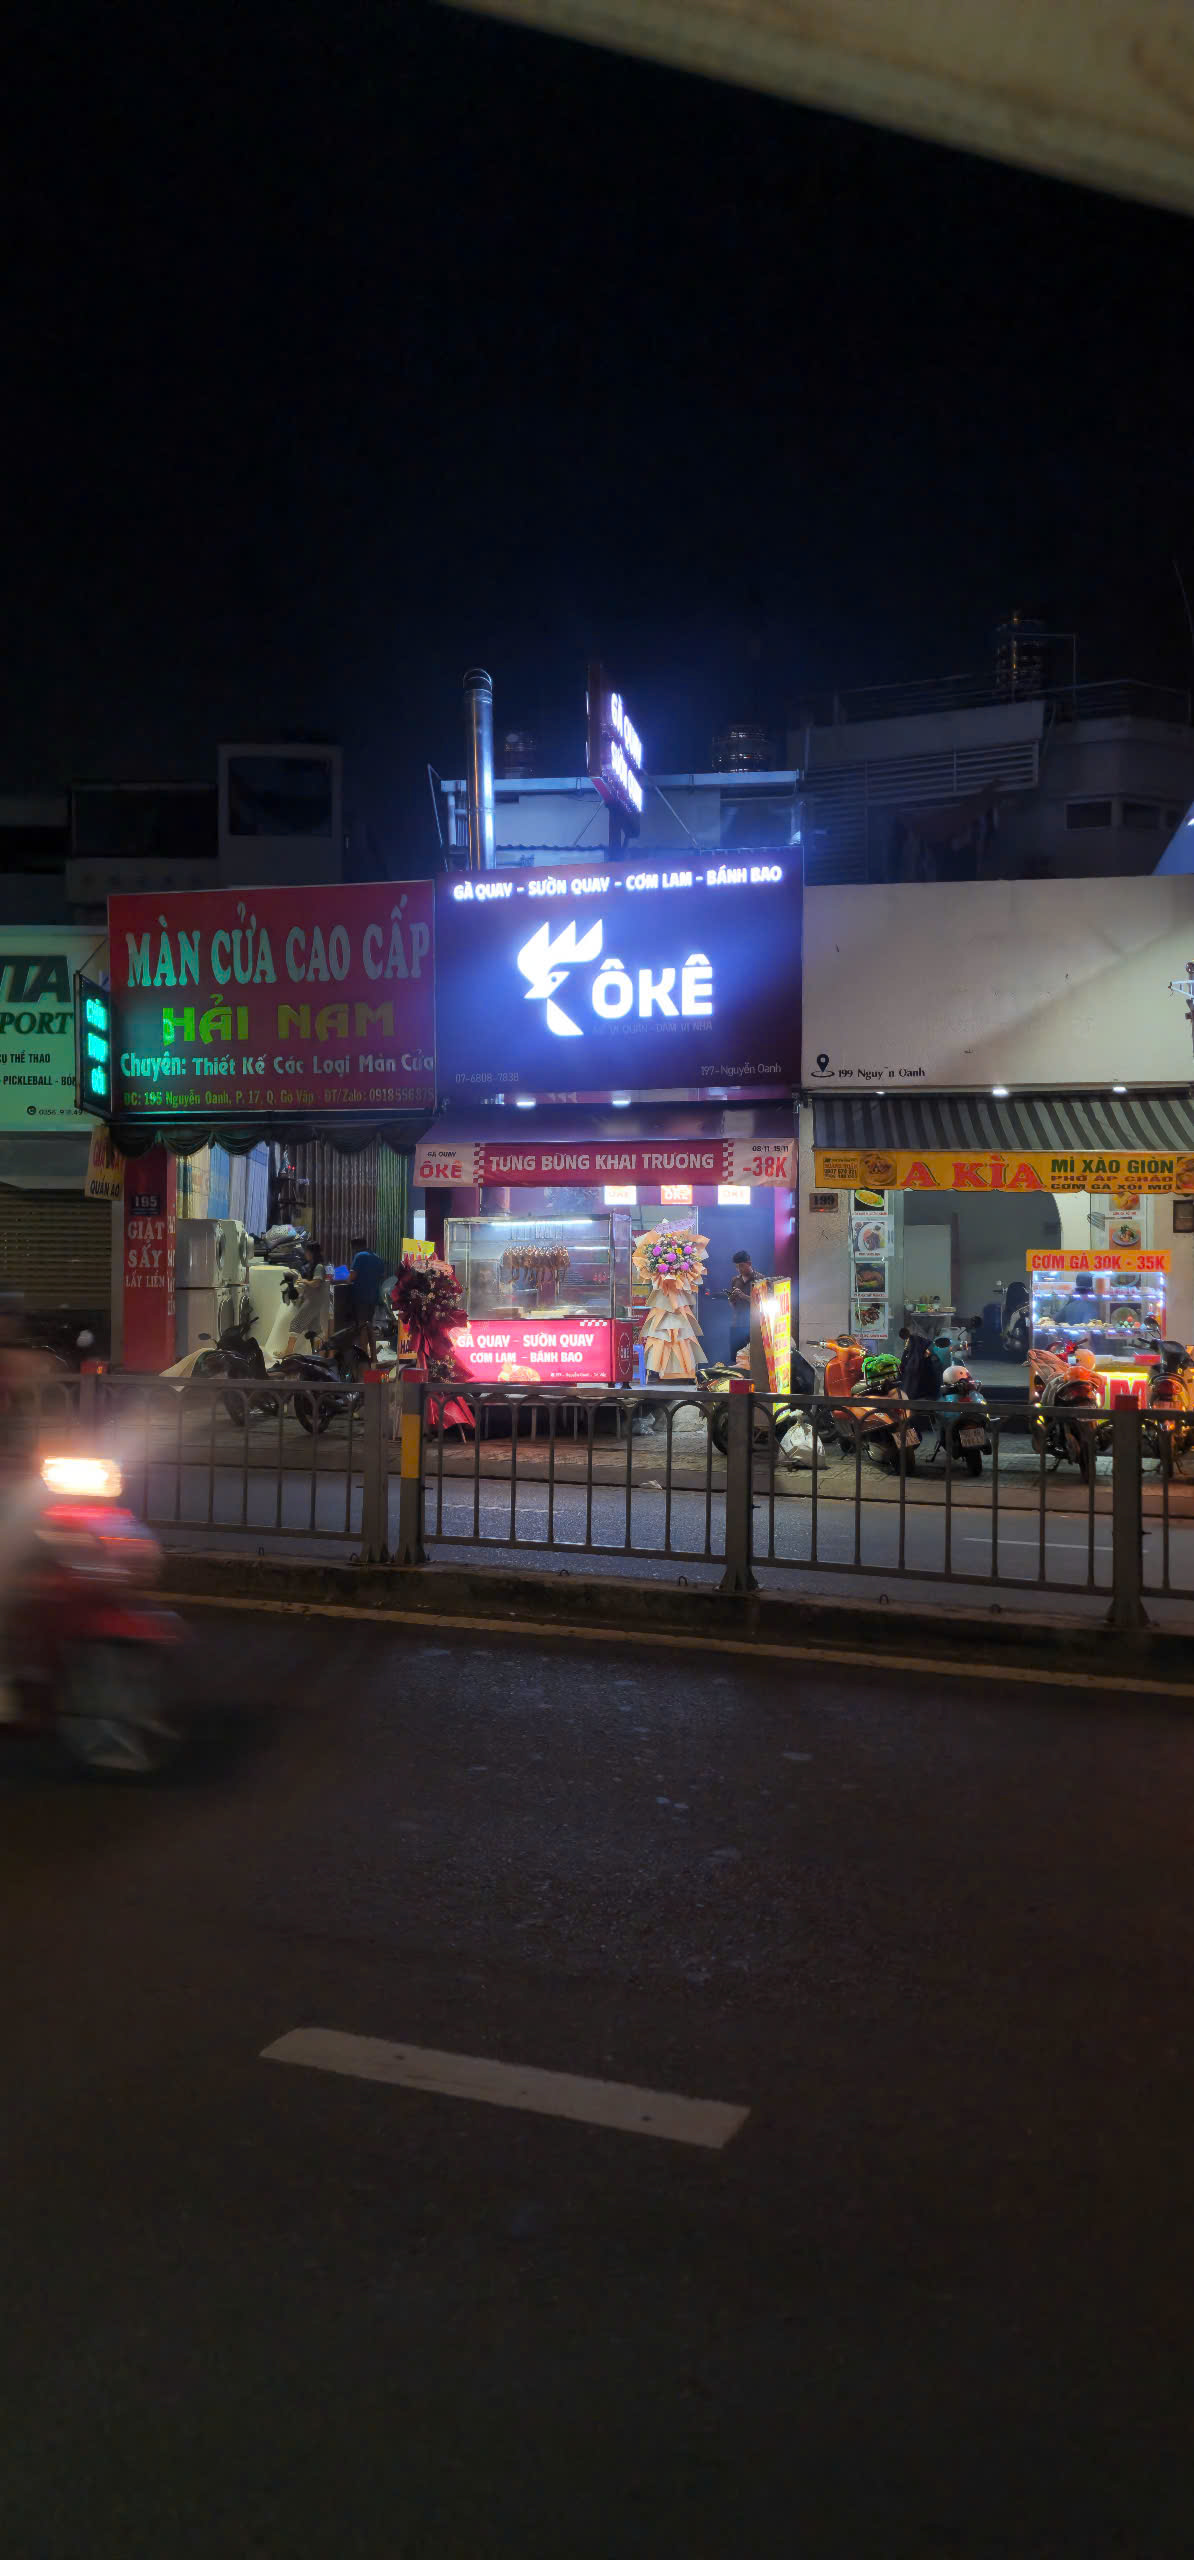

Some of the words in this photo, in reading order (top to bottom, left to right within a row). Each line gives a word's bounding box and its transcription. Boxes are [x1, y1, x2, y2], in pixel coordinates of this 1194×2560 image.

[453, 881, 474, 901] GÀ
[475, 882, 513, 900] QUAY
[528, 876, 567, 897] SƯỜN
[571, 876, 610, 895] QUAY
[626, 872, 659, 890] CƠM
[662, 871, 692, 888] LAM
[707, 863, 747, 885] BÁNH
[750, 865, 782, 883] BAO
[126, 914, 200, 987] MÀN
[211, 901, 277, 984] CỬA
[286, 924, 350, 983] CAO
[362, 893, 430, 980] CẤP
[591, 953, 713, 1019] ÔKÊ
[162, 994, 249, 1046] HẢI
[277, 1002, 394, 1045] NAM
[28, 1053, 50, 1064] THAO
[120, 1051, 187, 1083] Chuyên:
[192, 1054, 236, 1076] Thiết
[242, 1053, 267, 1075] Kế
[273, 1055, 304, 1075] Các
[313, 1055, 350, 1078] Loại
[758, 1062, 781, 1073] Oanh
[3, 1075, 53, 1086] PICKLEBALL
[838, 1069, 853, 1077] 199
[166, 1088, 201, 1108] Nguyễn
[419, 1160, 463, 1179] ÔKÊ
[595, 1154, 636, 1170] KHAI
[641, 1151, 714, 1169] TRƯƠNG
[743, 1156, 787, 1179] -38K
[1082, 1156, 1121, 1173] XÀO
[899, 1161, 940, 1187] A
[951, 1153, 1048, 1189] KÌA
[128, 1217, 165, 1240] GIẶT
[128, 1240, 163, 1267] SẤY
[1032, 1253, 1065, 1269] CƠM
[1094, 1255, 1121, 1269] 30K
[1136, 1255, 1165, 1270] 35K
[477, 1334, 510, 1348] QUAY
[523, 1332, 557, 1347] SƯỜN
[560, 1333, 594, 1347] QUAY
[470, 1351, 493, 1363] CƠM
[495, 1351, 517, 1363] LAM
[530, 1350, 558, 1363] BÁNH
[561, 1351, 583, 1363] BAO
